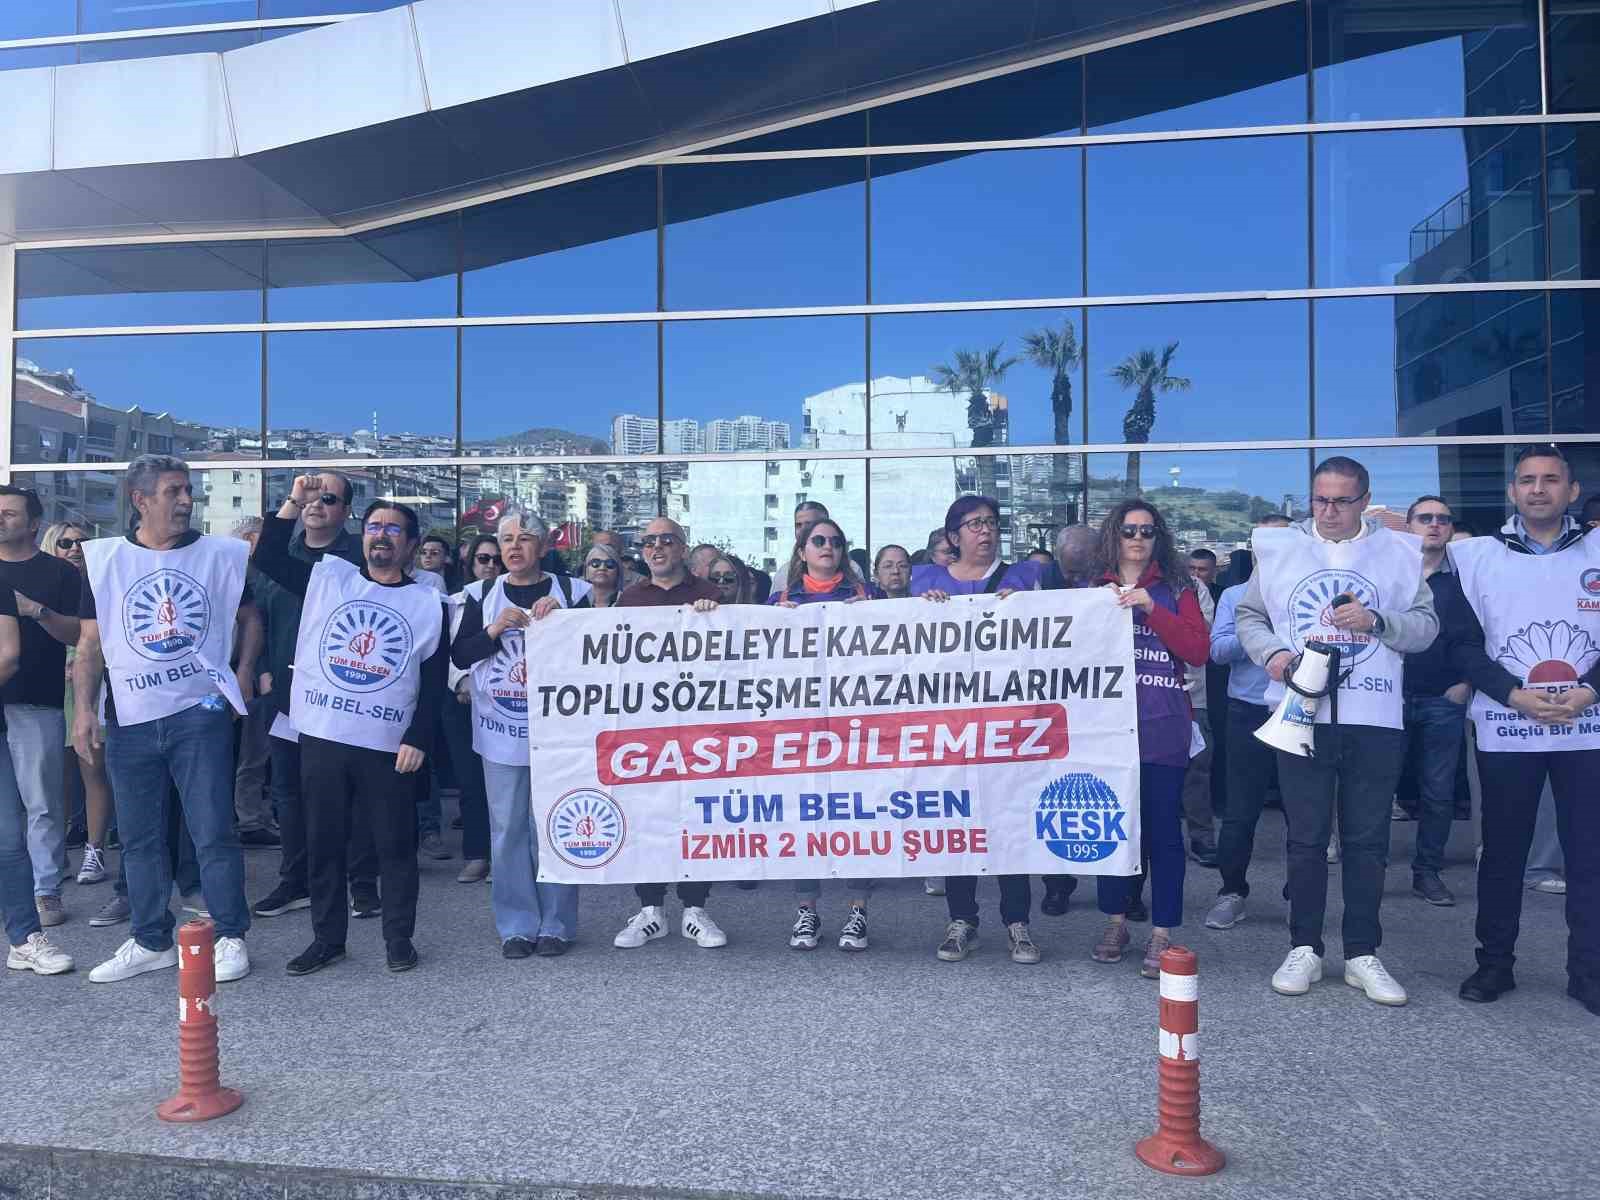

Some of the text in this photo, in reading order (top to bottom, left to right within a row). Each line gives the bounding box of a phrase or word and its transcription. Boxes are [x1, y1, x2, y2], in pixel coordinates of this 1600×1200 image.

[582, 612, 1073, 665] MÜCADELEYLE KAZANDIĞIMIZ
[125, 667, 162, 693] TÜM
[328, 656, 391, 676] TÜM BEL-SEN
[344, 671, 367, 680] 1990
[304, 688, 405, 723] TÜM BEL-SEN
[538, 666, 1124, 717] TOPLU SÖZLEŞME KAZANIMLARIMIZ
[1485, 710, 1528, 721] Emek
[1496, 726, 1544, 739] Güçlü
[610, 718, 1052, 779] GASP EDİLEMEZ
[694, 788, 971, 824] TÜM BEL-SEN
[1035, 811, 1128, 841] KESK
[681, 828, 988, 862] İZMİR 2 NOLU ŞUBE
[1064, 843, 1099, 860] 1995
